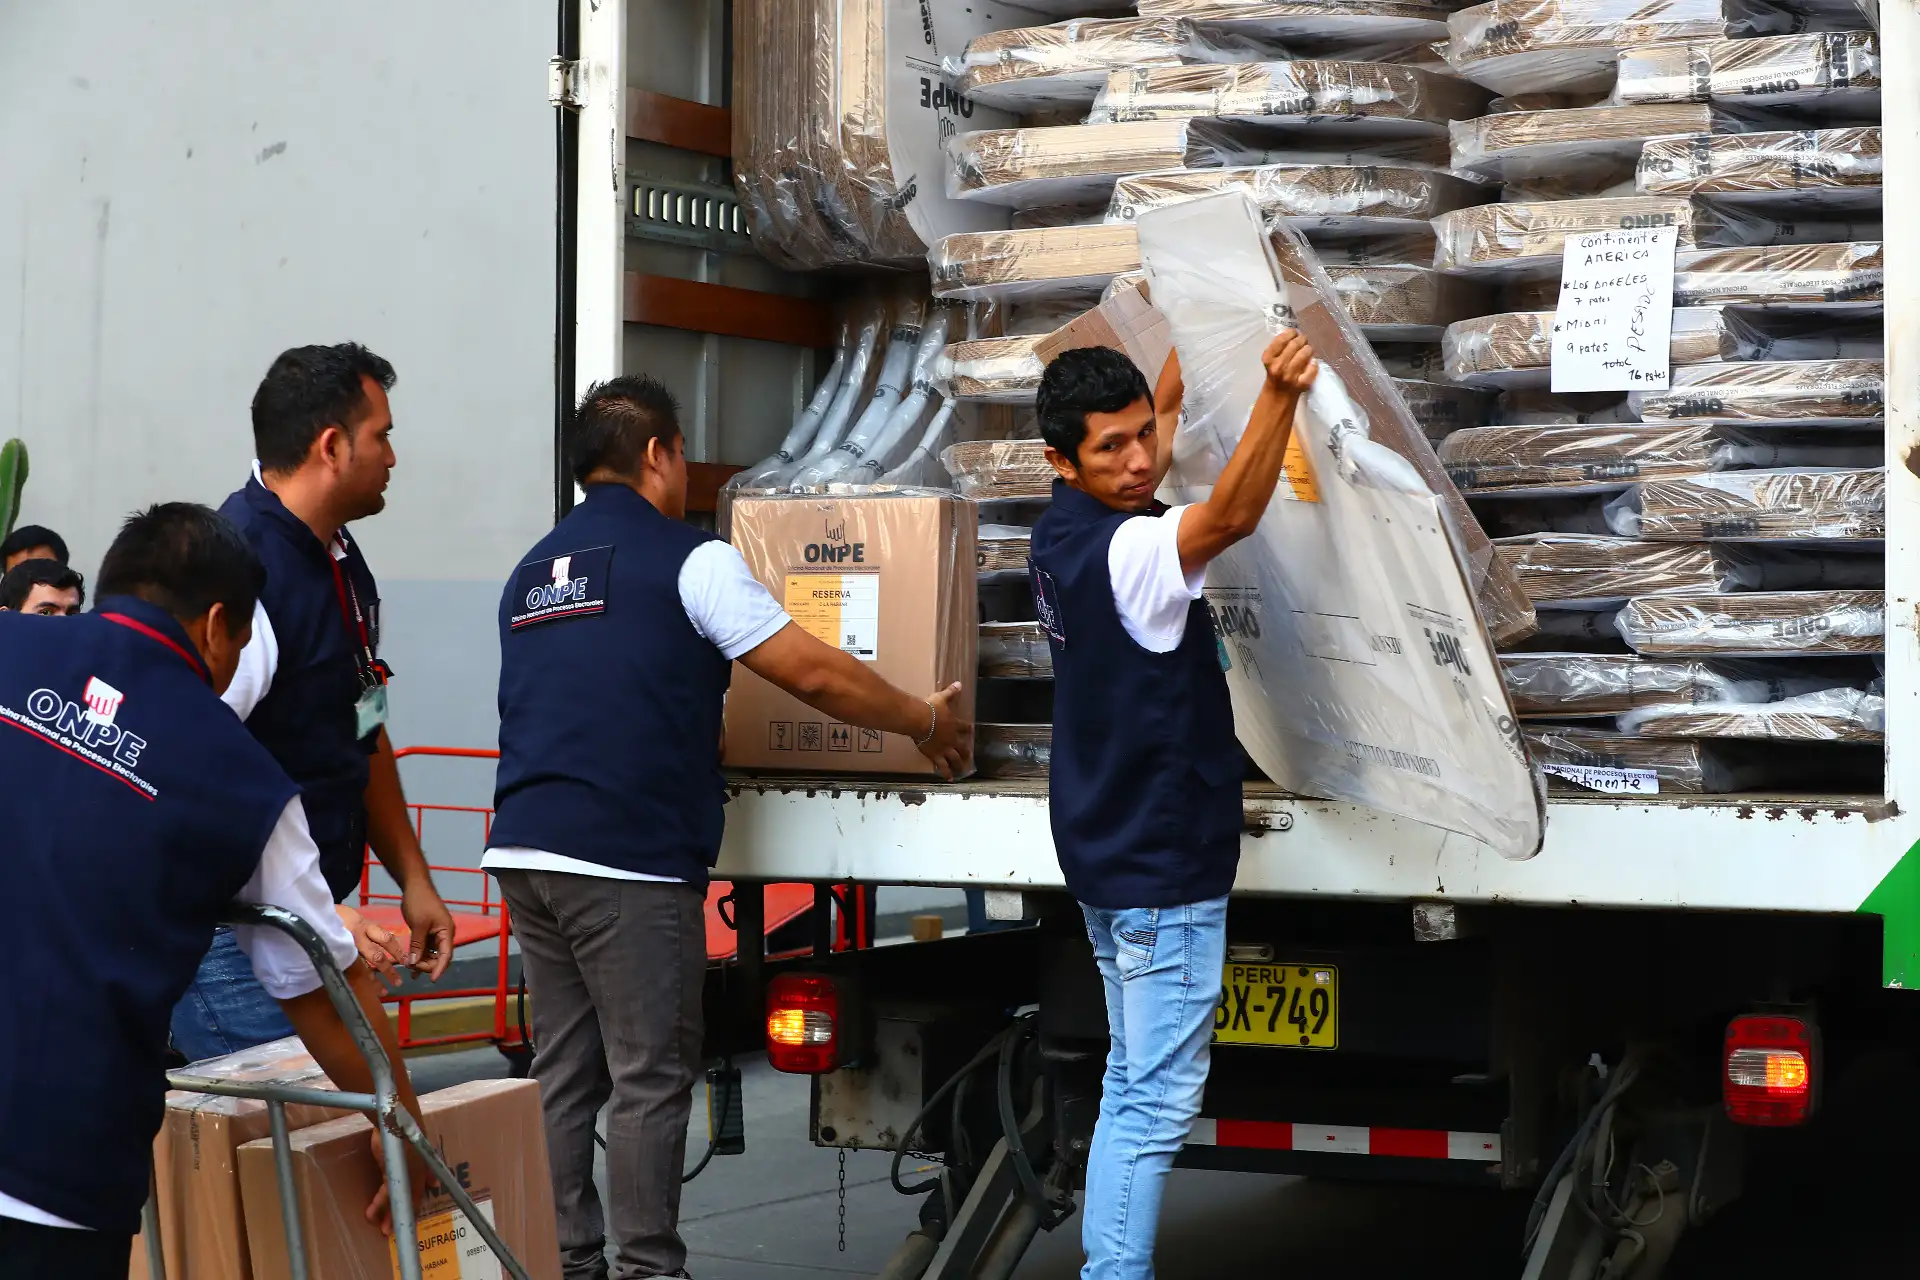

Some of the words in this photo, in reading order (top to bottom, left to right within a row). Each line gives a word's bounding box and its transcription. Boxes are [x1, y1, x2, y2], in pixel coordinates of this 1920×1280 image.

[1742, 78, 1799, 95] ONPE
[920, 77, 974, 119] ONPE
[1620, 212, 1675, 230] ONPE
[1574, 297, 1582, 305] 7
[1566, 342, 1575, 353] 9
[804, 542, 865, 563] ONPE
[526, 577, 588, 609] ONPE
[812, 589, 852, 599] RESERVA
[552, 604, 574, 612] Procesos
[575, 600, 604, 608] Electorales
[1772, 615, 1831, 638] ONPE
[27, 688, 147, 768] ONPE
[0, 704, 20, 721] icina
[20, 714, 61, 741] Nacional
[60, 736, 73, 747] de
[72, 741, 113, 768] Procesos
[112, 762, 159, 797] Electorales
[1584, 768, 1592, 776] DE
[1593, 769, 1627, 779] PROCESOS
[1233, 967, 1285, 984] PERU
[419, 1227, 467, 1252] SUFRAGIO
